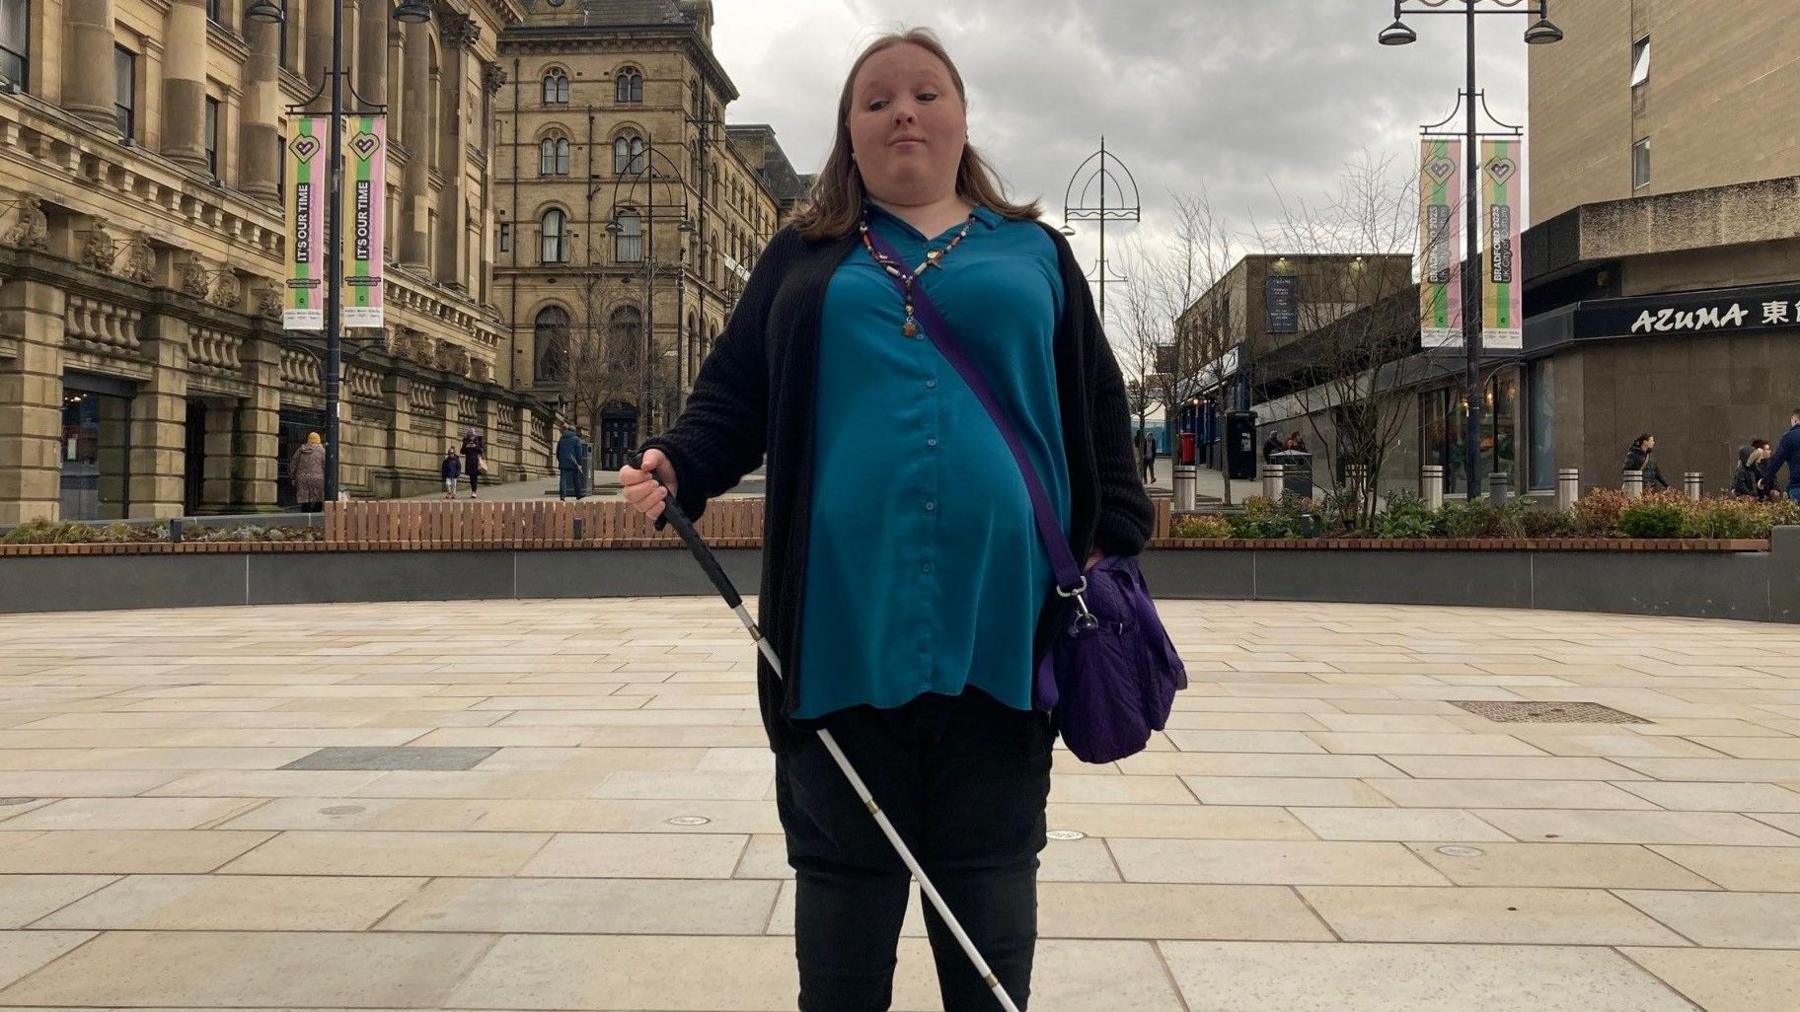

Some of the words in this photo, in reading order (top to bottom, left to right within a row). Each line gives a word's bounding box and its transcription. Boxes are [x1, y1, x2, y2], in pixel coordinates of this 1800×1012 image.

[298, 184, 308, 212] TIME
[358, 181, 368, 210] TIME
[297, 214, 308, 239] OUR
[357, 211, 368, 237] OUR
[297, 241, 307, 261] IT'S
[357, 238, 367, 259] IT'S
[1493, 230, 1502, 281] BRADFORD
[1502, 269, 1510, 281] UK
[1631, 303, 1749, 333] AZUMA
